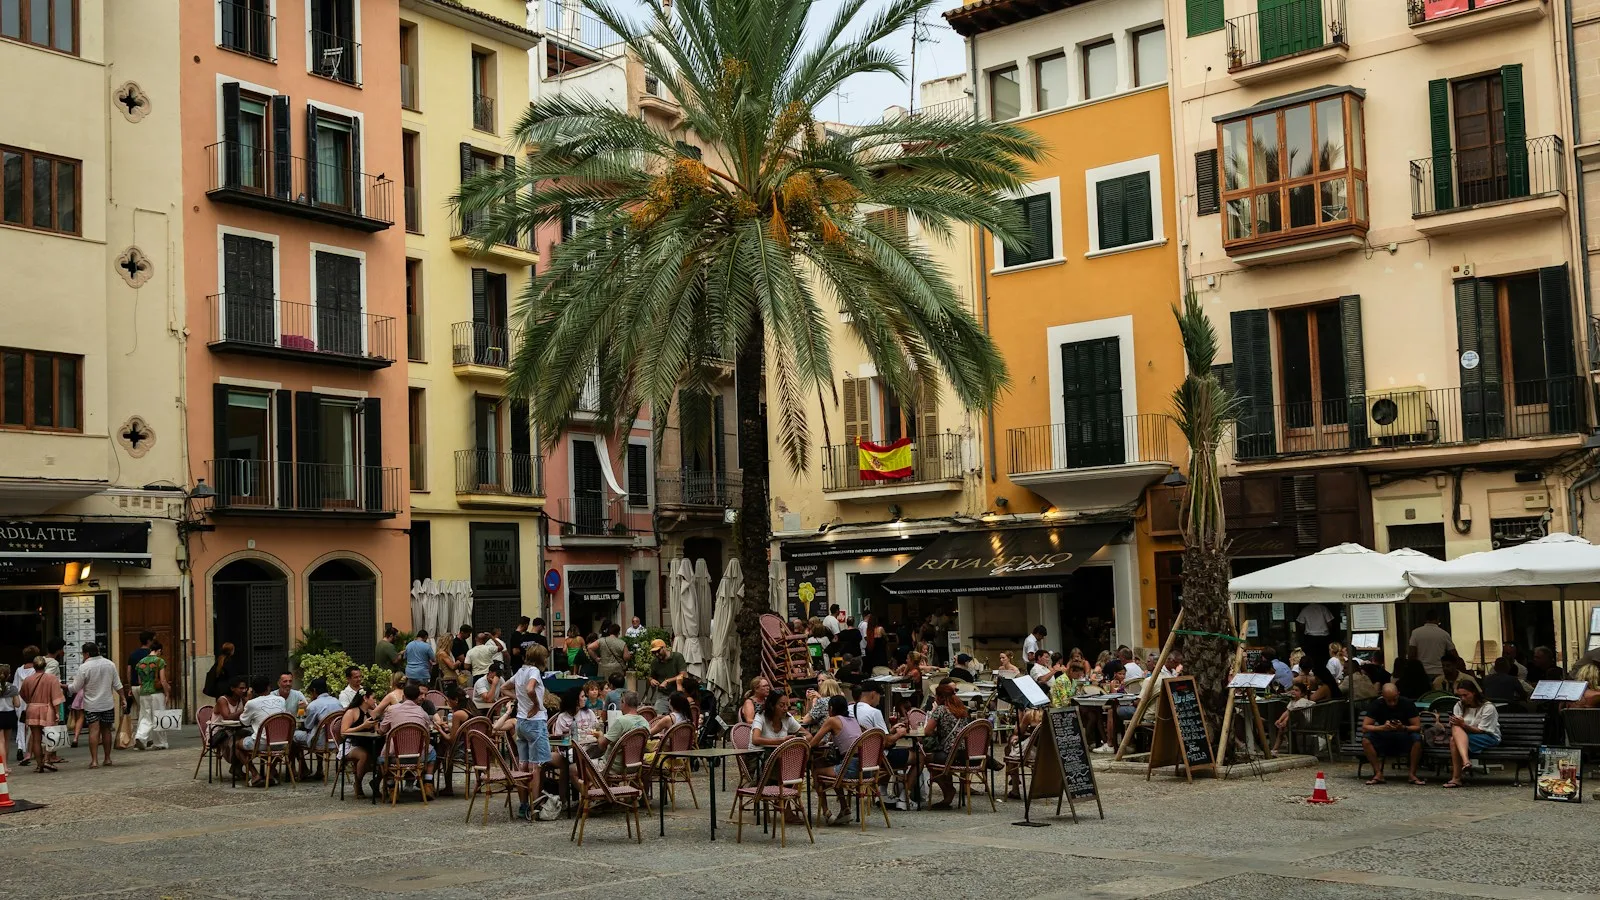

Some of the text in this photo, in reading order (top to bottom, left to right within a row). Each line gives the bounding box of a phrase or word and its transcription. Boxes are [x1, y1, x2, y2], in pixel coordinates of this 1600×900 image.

[917, 552, 1073, 570] RIVARENO
[989, 561, 1055, 576] Gelato
[1233, 590, 1273, 600] Alhambra
